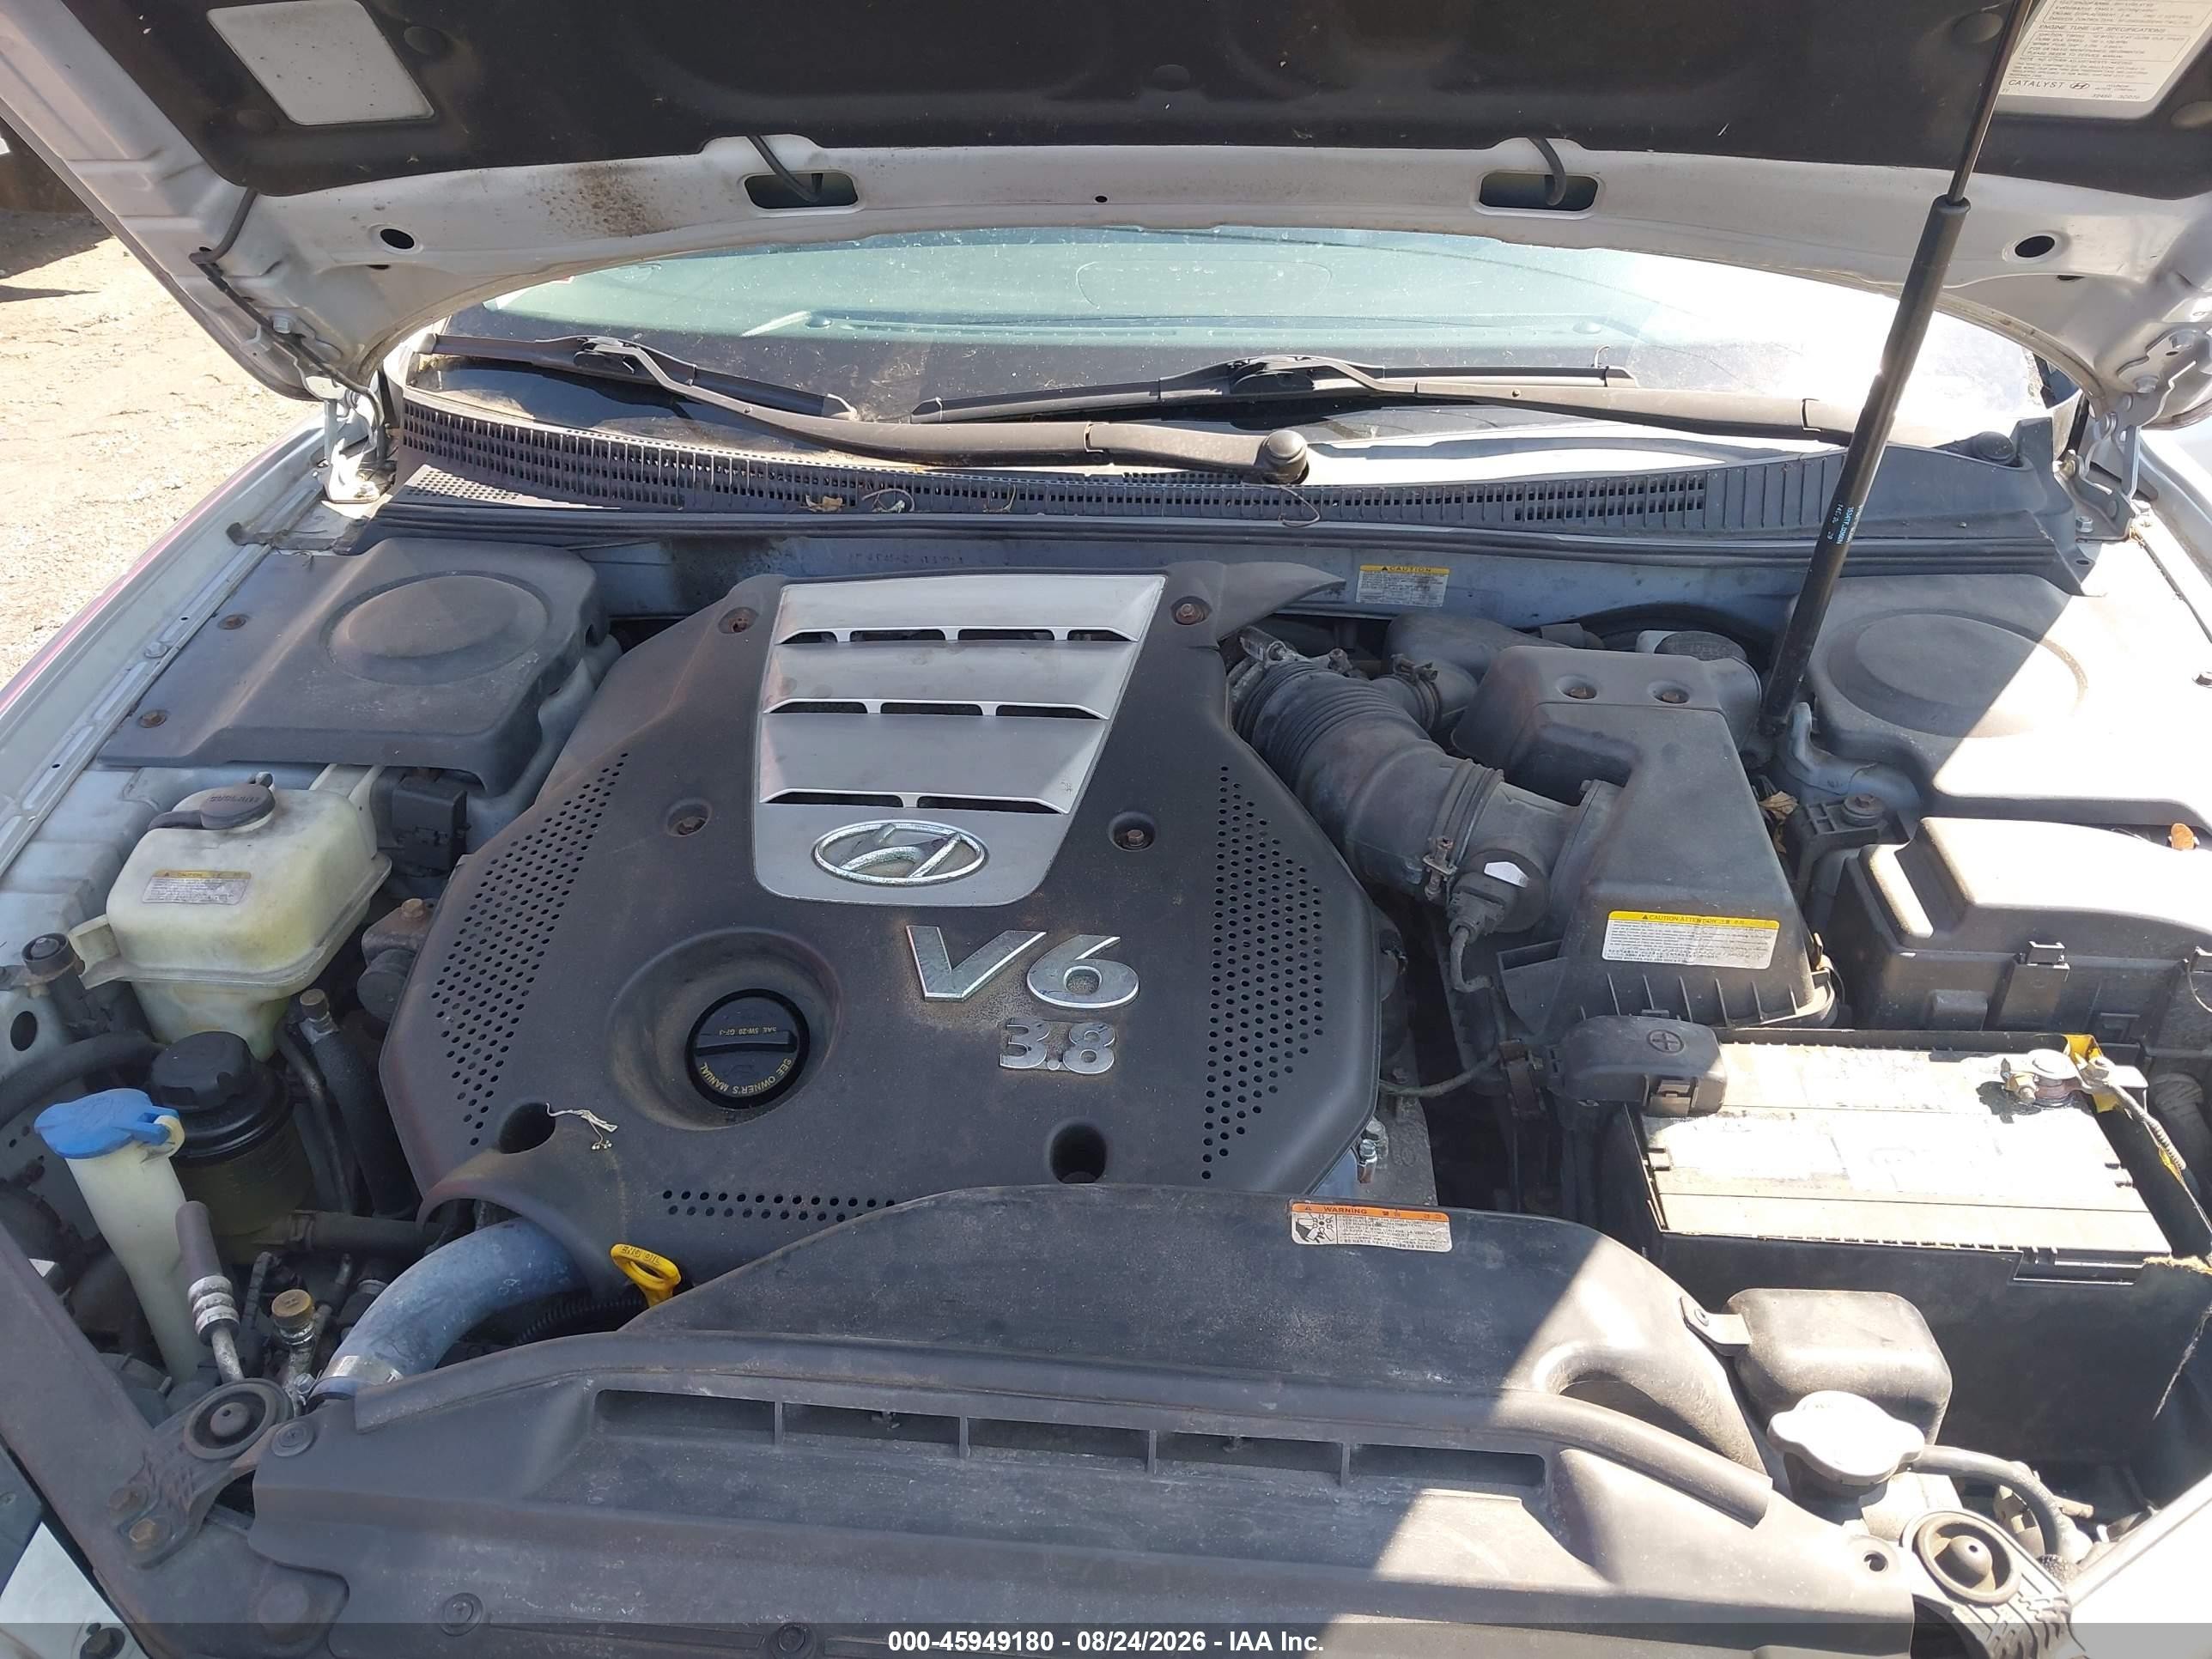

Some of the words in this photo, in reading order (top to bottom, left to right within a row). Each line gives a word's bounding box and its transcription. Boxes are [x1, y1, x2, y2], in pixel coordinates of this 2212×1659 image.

[2008, 79, 2065, 88] CATALYST
[1680, 915, 1717, 925] ATTENTION
[906, 925, 1139, 1008] V6
[1000, 1017, 1115, 1073] 3.8
[700, 1061, 730, 1092] MANUAL
[775, 1058, 792, 1077] SEE
[732, 1075, 776, 1095] OWNER'S
[1322, 1206, 1368, 1214] WARNING
[621, 1245, 641, 1258] ENG
[644, 1252, 660, 1265] OIL
